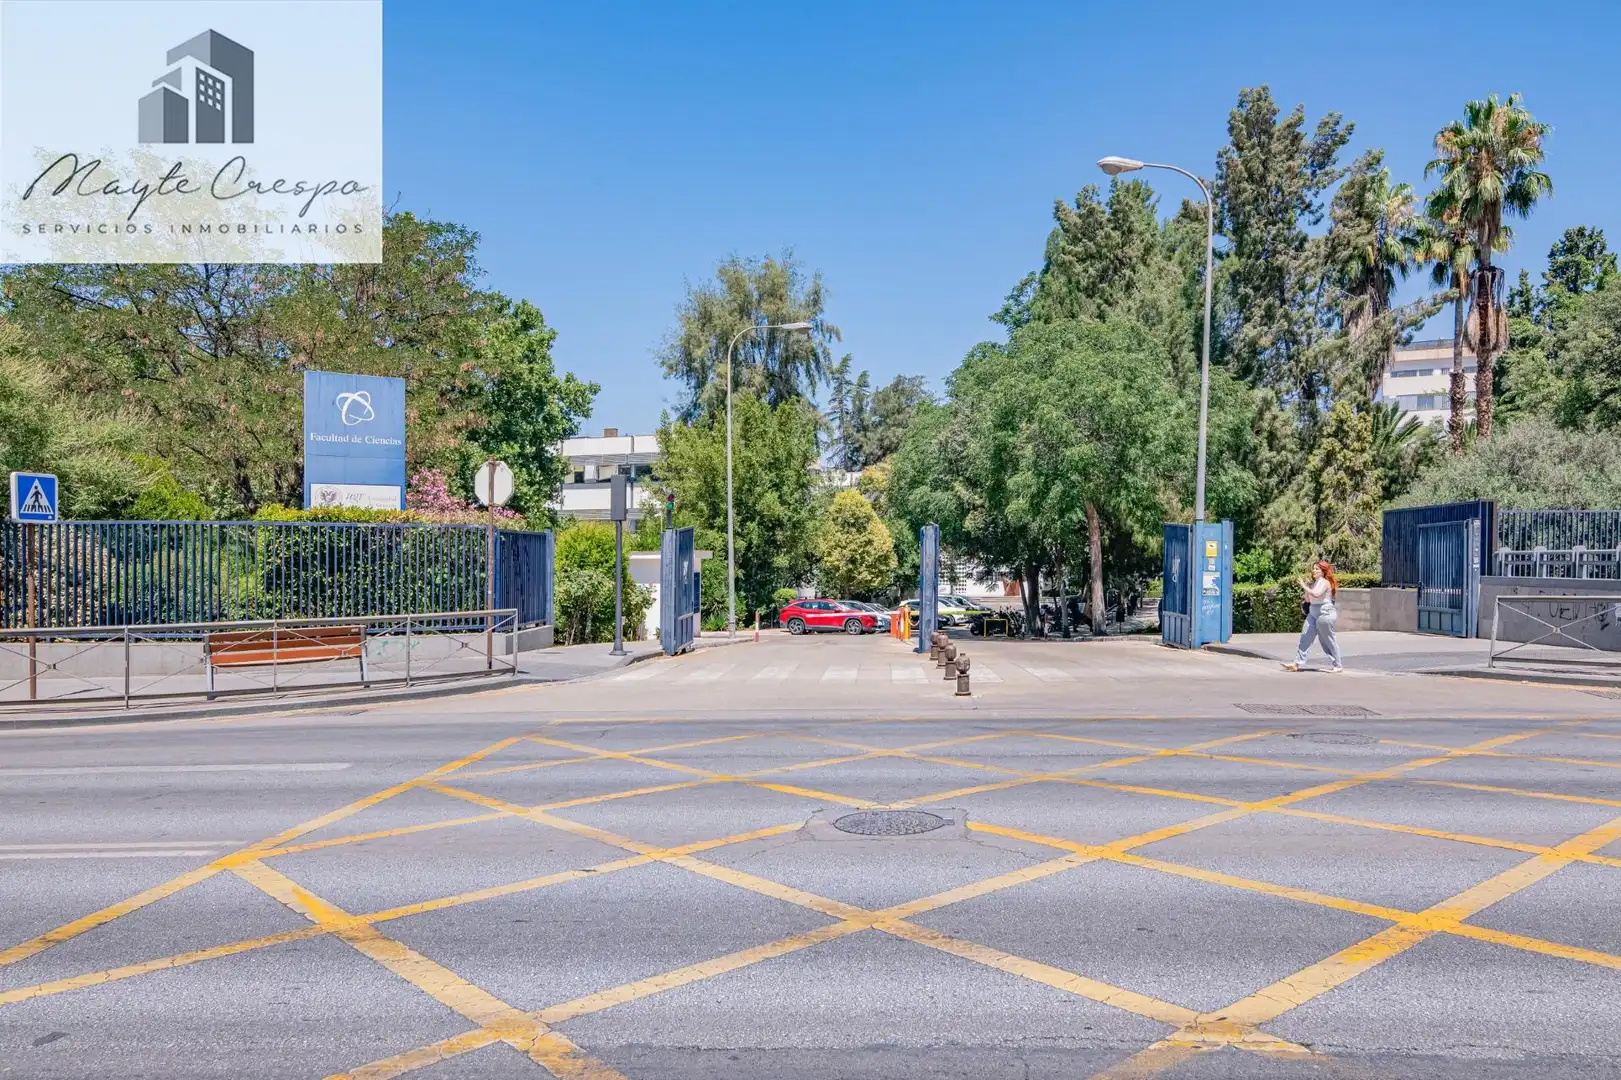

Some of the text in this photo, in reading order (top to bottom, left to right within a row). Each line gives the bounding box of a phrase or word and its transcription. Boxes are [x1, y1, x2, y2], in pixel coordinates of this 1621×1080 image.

[310, 432, 402, 446] Facultad de Ciencias
